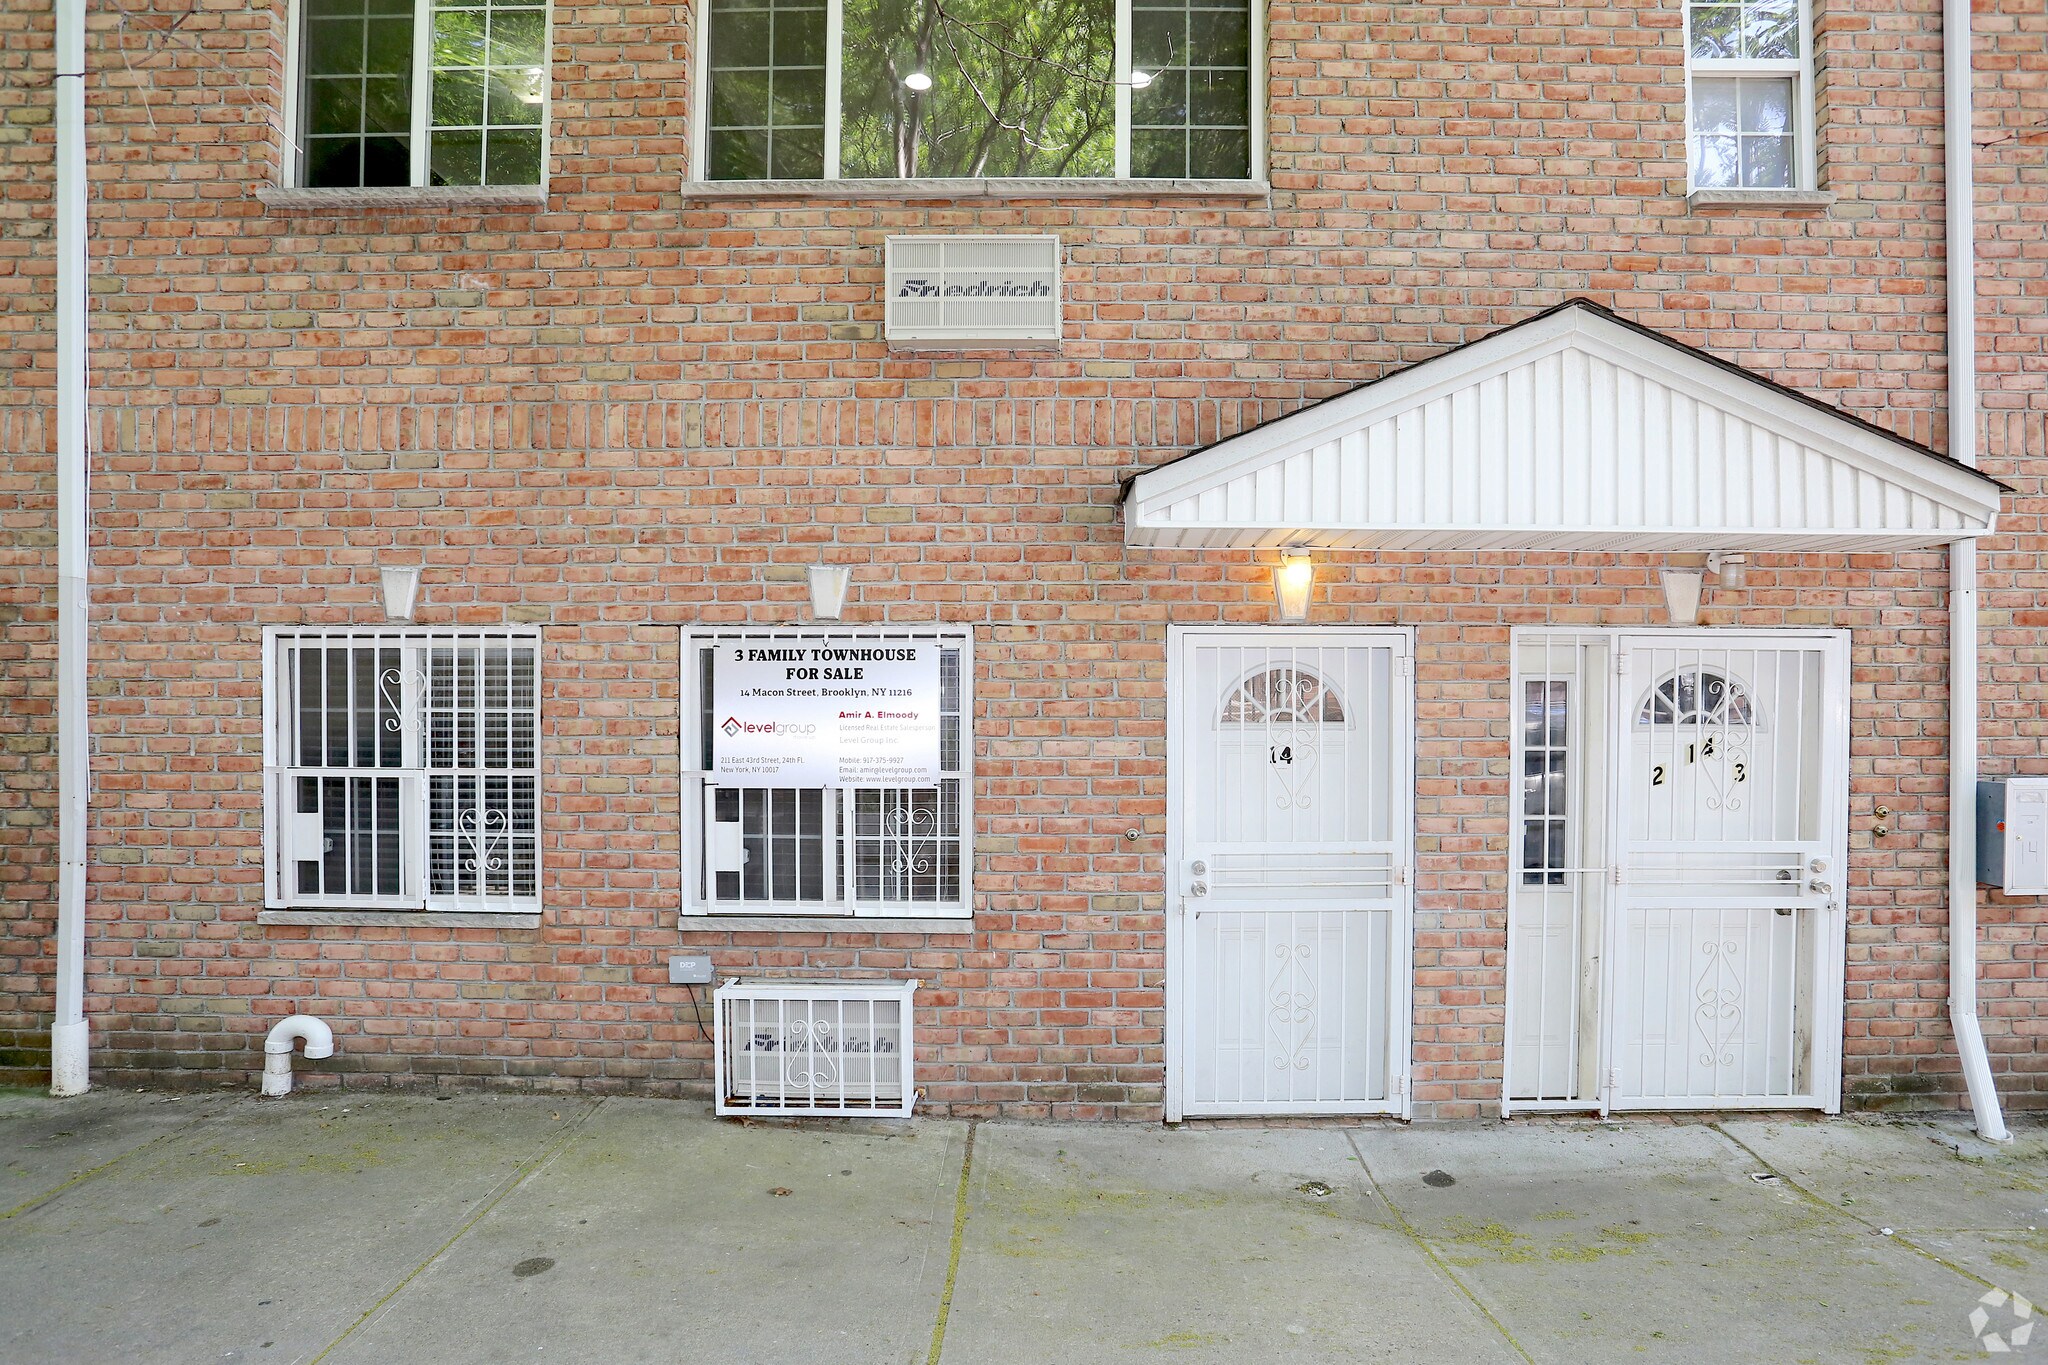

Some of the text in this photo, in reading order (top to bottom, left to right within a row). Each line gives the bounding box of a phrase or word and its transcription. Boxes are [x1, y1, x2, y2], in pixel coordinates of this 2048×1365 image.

[734, 649, 916, 662] 3 FAMILY TOWNHOUSE
[786, 667, 864, 680] FOR SALE
[740, 688, 912, 698] 14 Macon Street, Brooklyn, NY 11216
[838, 711, 919, 720] Amir A. Elmoody
[743, 721, 816, 736] levelgroup
[899, 724, 936, 732] Salesperson
[839, 736, 859, 744] Level
[860, 736, 884, 745] Group
[1269, 746, 1293, 764] 14
[760, 756, 780, 764] Street,
[734, 766, 751, 774] York,
[859, 766, 928, 775] amir@levelgroup.com
[865, 776, 931, 784] www.levelgroup.com
[1652, 766, 1664, 786] 2
